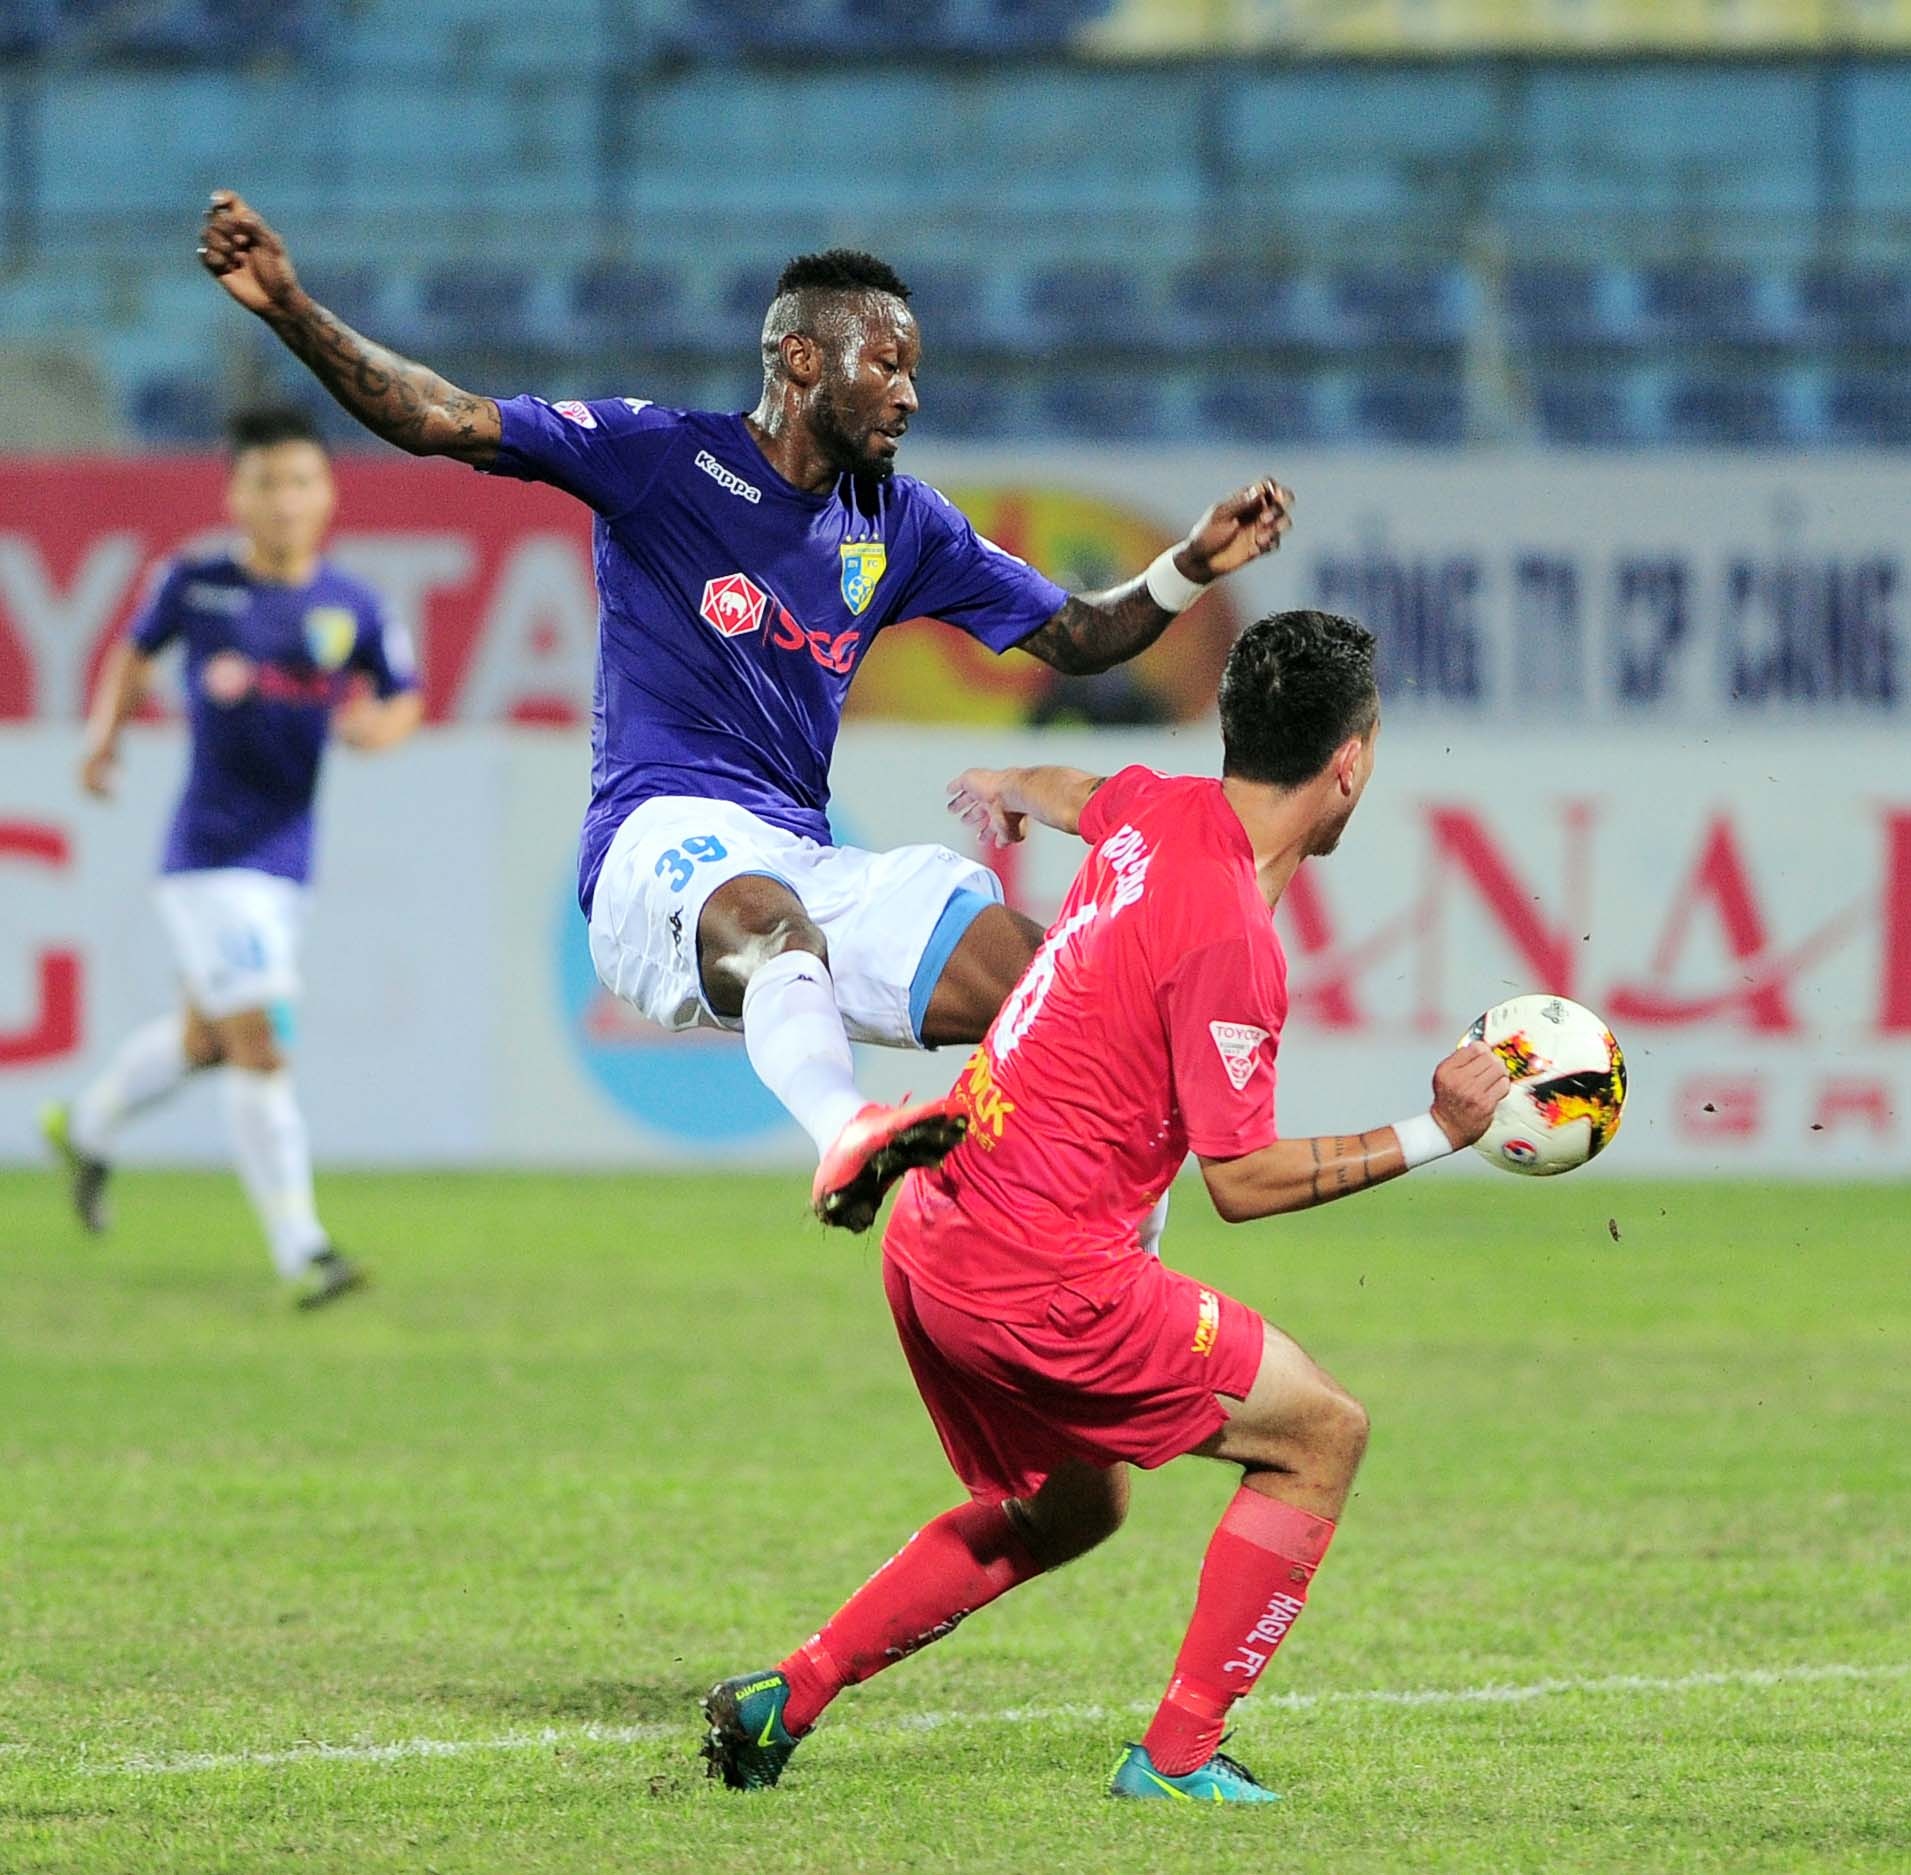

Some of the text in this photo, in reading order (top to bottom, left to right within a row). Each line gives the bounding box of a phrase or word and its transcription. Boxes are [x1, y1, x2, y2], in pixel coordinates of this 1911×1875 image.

[695, 450, 761, 504] Kappa
[774, 608, 860, 674] SCG
[654, 834, 728, 893] 39
[1222, 1591, 1305, 1678] HAGL FC
